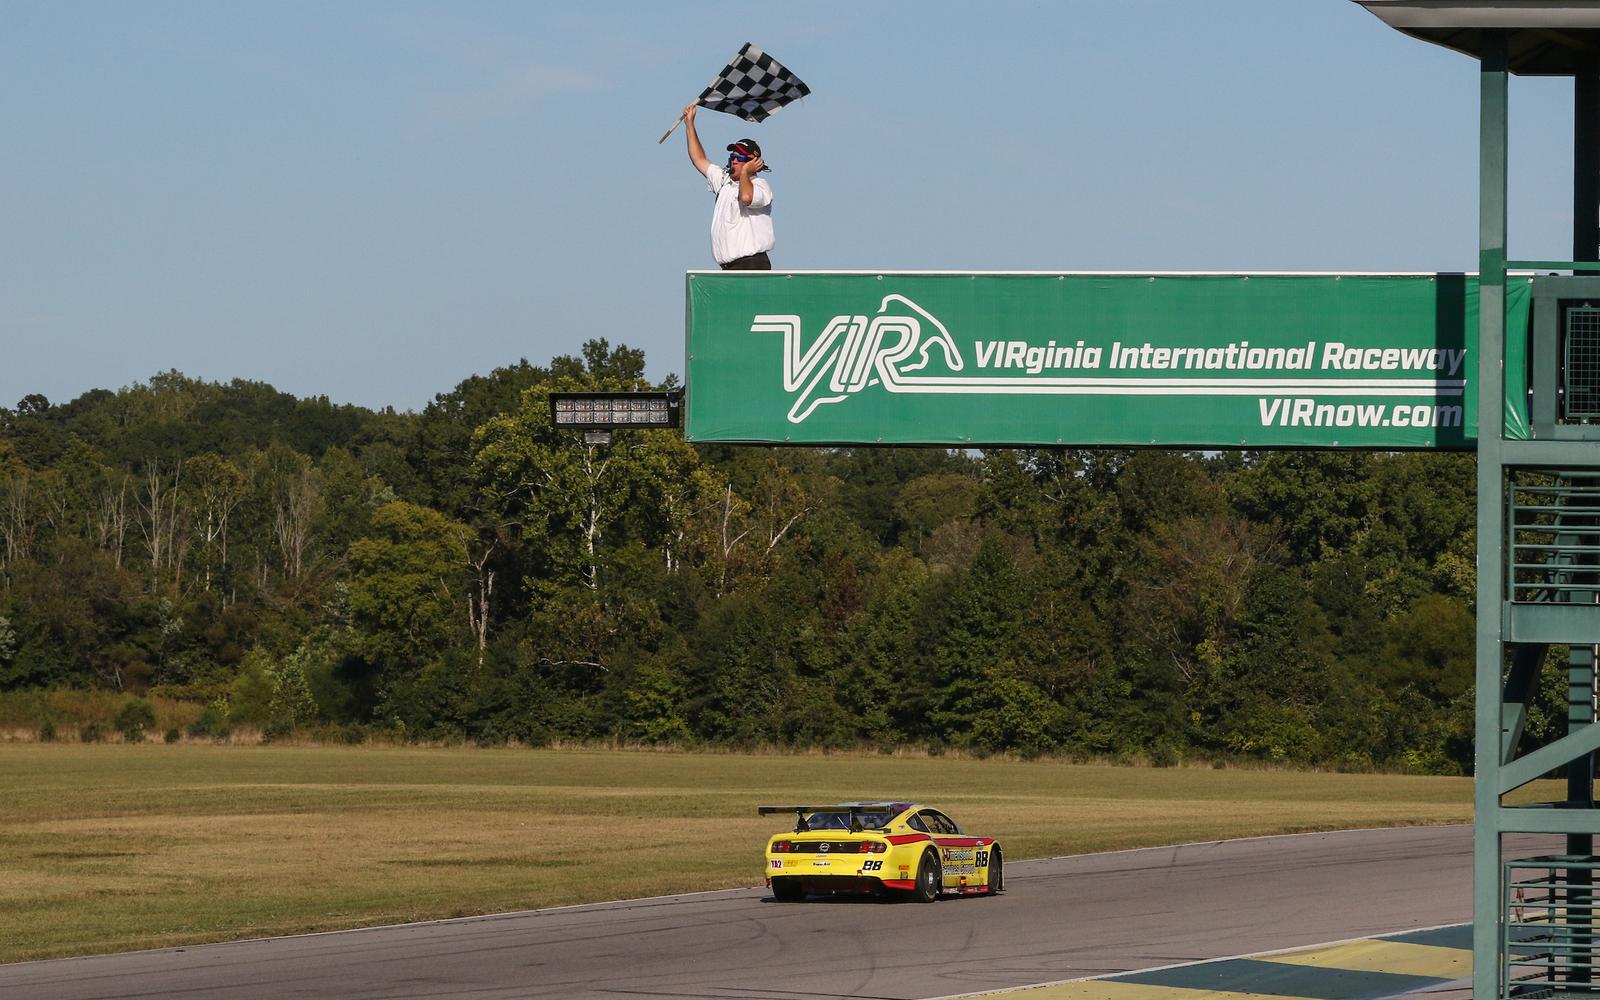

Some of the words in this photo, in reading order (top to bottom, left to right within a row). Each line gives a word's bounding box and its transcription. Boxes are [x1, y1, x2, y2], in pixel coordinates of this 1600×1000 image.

[750, 314, 921, 393] VIR
[974, 339, 1103, 375] VIRginia
[1108, 341, 1317, 371] International
[1320, 341, 1467, 376] Raceway
[1257, 398, 1463, 428] VIRnow.com
[771, 860, 782, 869] TA2
[862, 861, 883, 871] 88
[975, 851, 989, 868] 88
